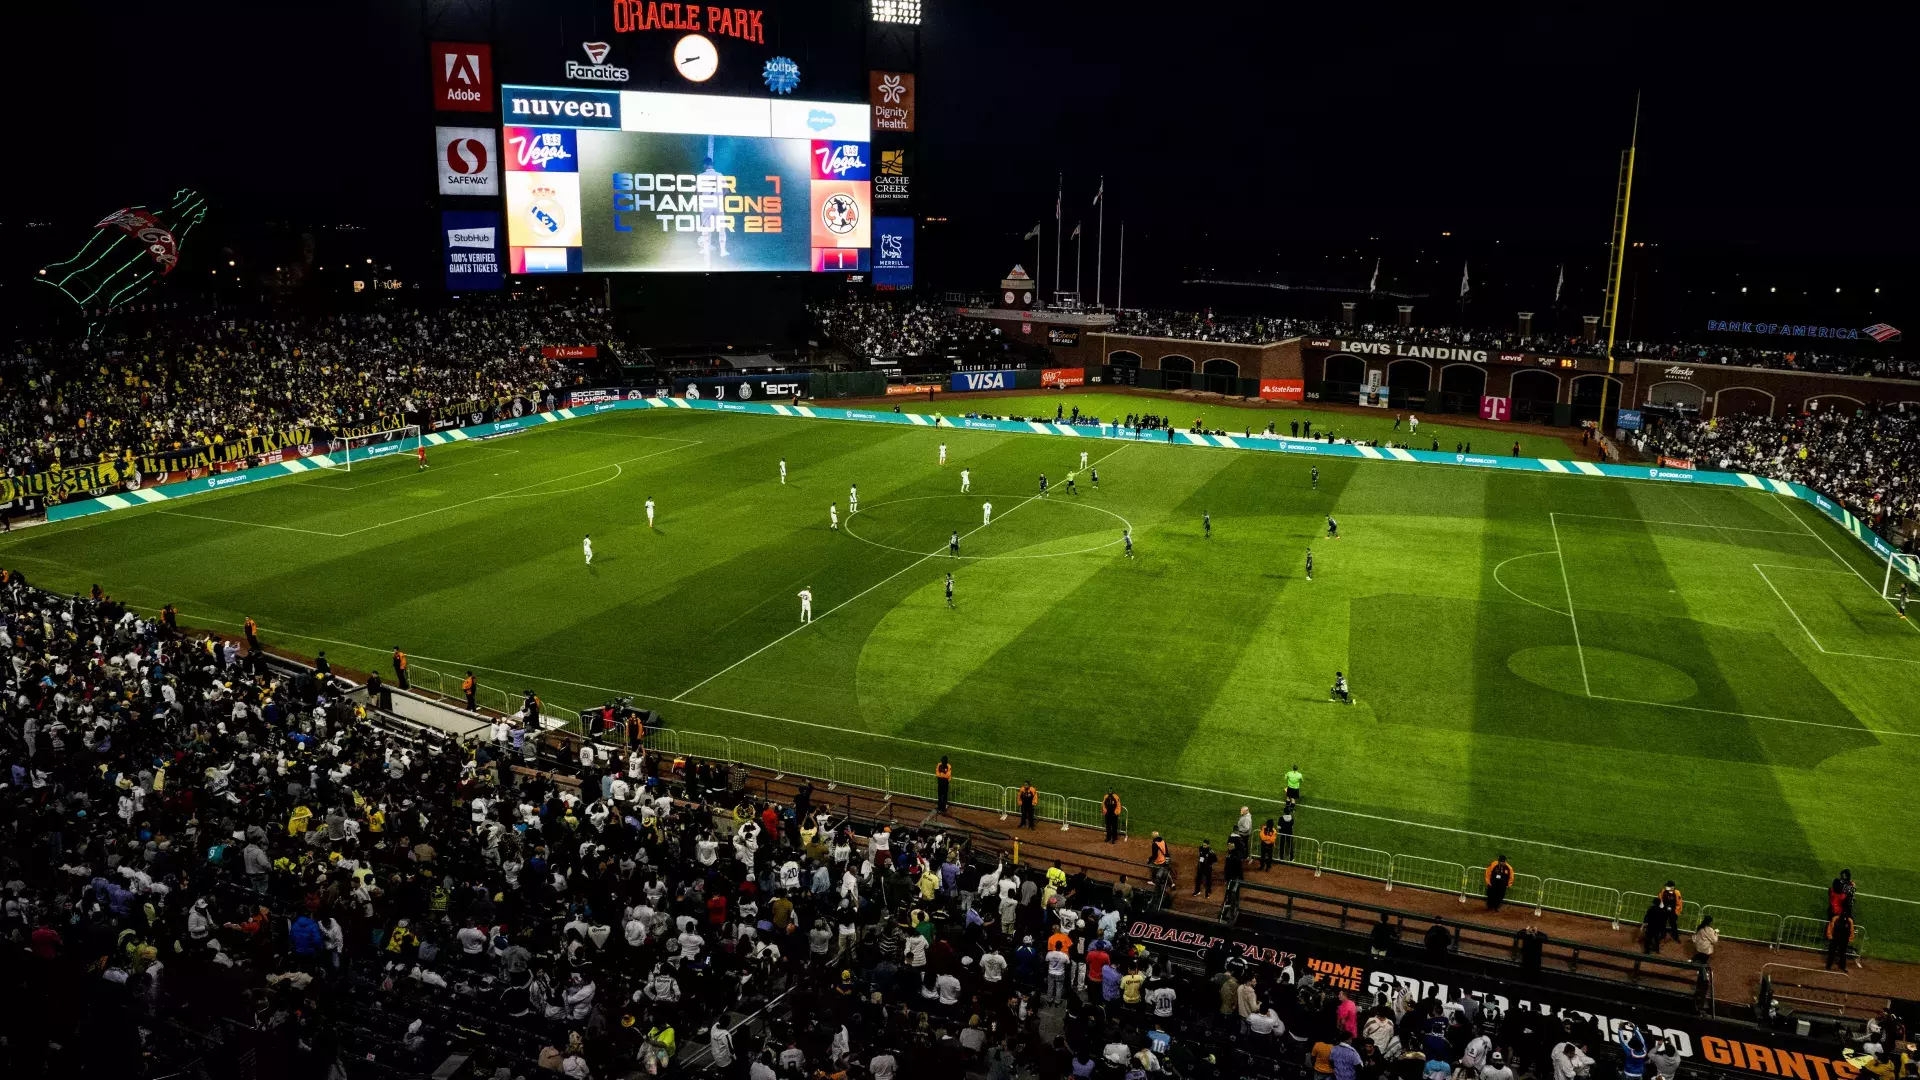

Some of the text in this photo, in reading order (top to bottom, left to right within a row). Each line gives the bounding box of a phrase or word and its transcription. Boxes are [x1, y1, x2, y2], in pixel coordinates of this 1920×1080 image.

[613, 0, 765, 44] ORACLE PARK
[566, 61, 629, 81] Fanatics
[766, 62, 798, 75] coupa
[447, 88, 481, 101] Adobe
[512, 98, 612, 118] nuveen
[876, 106, 908, 120] Dignity
[544, 135, 560, 144] LAS
[509, 135, 572, 168] Vegas
[816, 147, 866, 176] Vegas
[448, 176, 488, 184] SAFEWAY
[612, 173, 737, 193] SOCCER
[875, 176, 910, 185] CACHE
[876, 185, 908, 193] CREEK
[613, 194, 782, 213] CHAMPIONS
[656, 215, 782, 233] TOUR 22
[454, 233, 490, 242] StubHub
[451, 253, 496, 263] 100% VERIFIED
[838, 252, 843, 268] 1
[450, 264, 498, 273] GIANTS TICKETS
[1707, 320, 1859, 339] BANK OF AMERICA
[1397, 345, 1488, 363] LANDING
[1664, 366, 1694, 376] Alaska
[964, 373, 1004, 389] VISA
[571, 390, 606, 398] SOCCER
[767, 384, 798, 394] SCT
[571, 395, 620, 403] CHAMPIONS
[1465, 457, 1497, 465] socios.com
[216, 474, 247, 485] socios.com
[1307, 957, 1364, 980] HOME
[1328, 976, 1361, 992] THE
[1701, 1035, 1864, 1080] GIANTS
